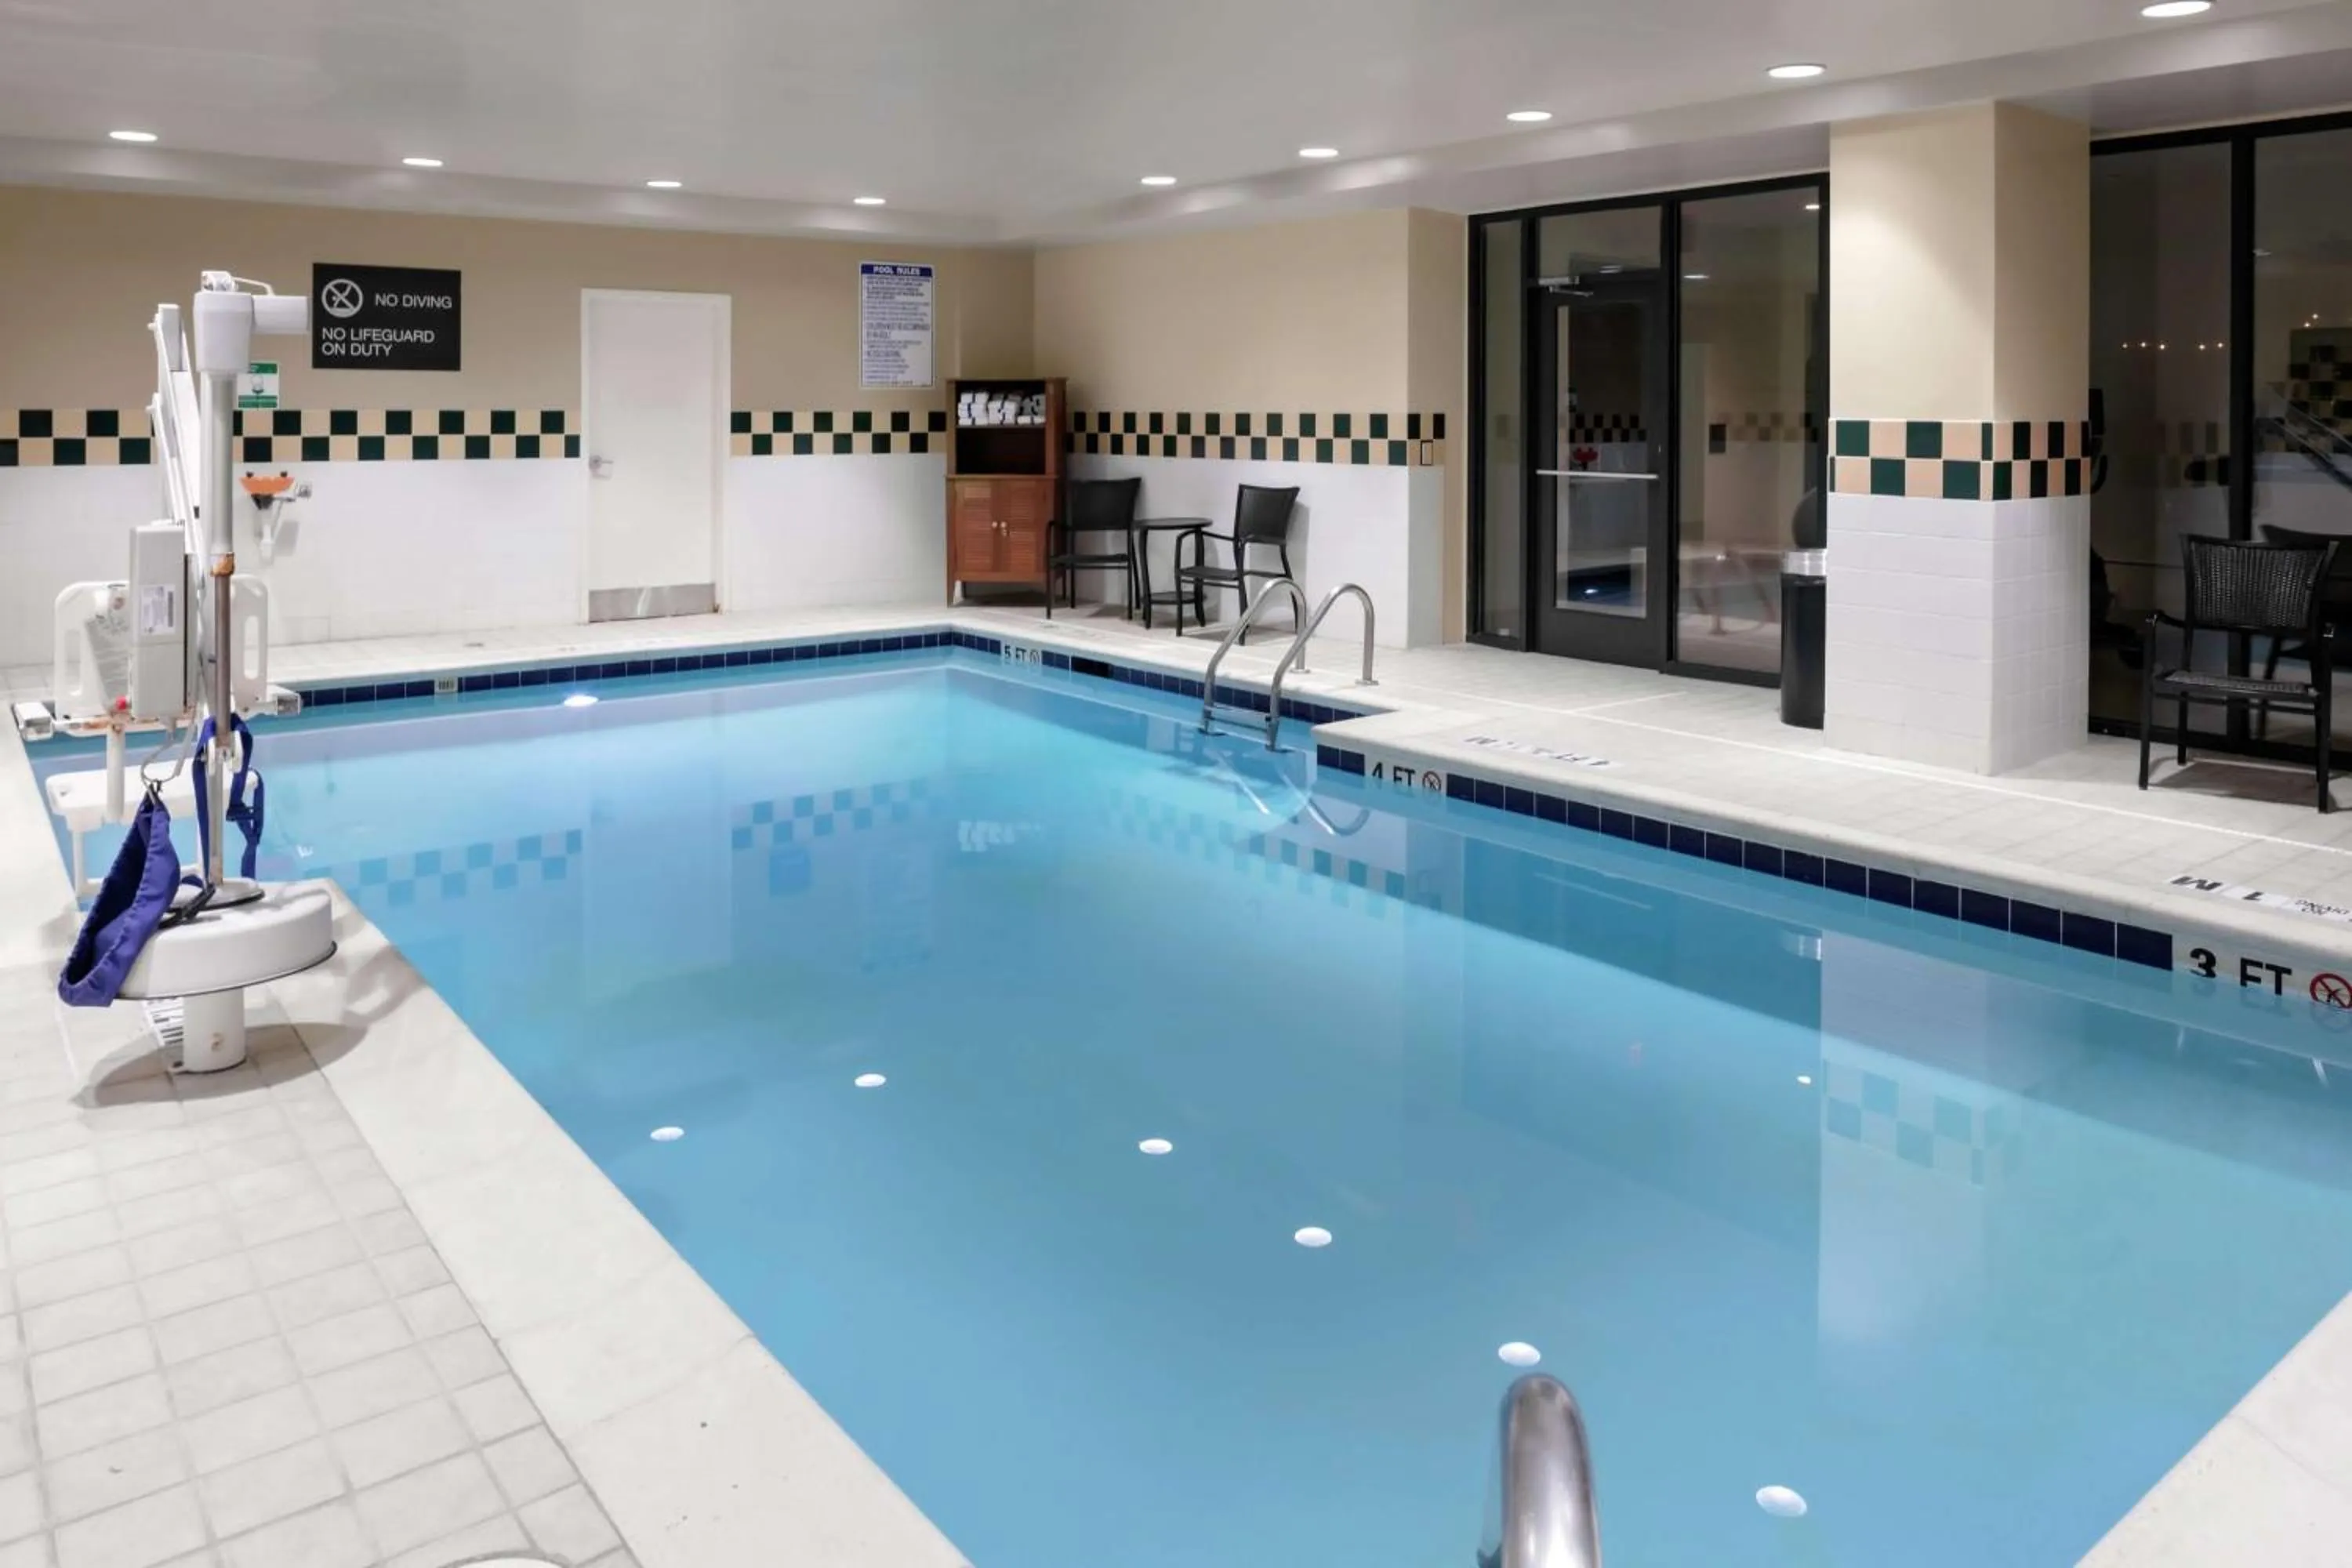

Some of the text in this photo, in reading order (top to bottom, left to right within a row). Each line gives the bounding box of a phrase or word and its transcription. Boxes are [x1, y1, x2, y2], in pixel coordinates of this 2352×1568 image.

[873, 265, 920, 277] POOL RULES
[375, 292, 452, 309] NO DIVING
[321, 327, 435, 343] NO LIFEGUARD
[321, 343, 392, 357] ON DUTY
[1004, 644, 1027, 662] 5 FT
[1393, 764, 1416, 786] FT
[2189, 947, 2292, 996] 3 FT
